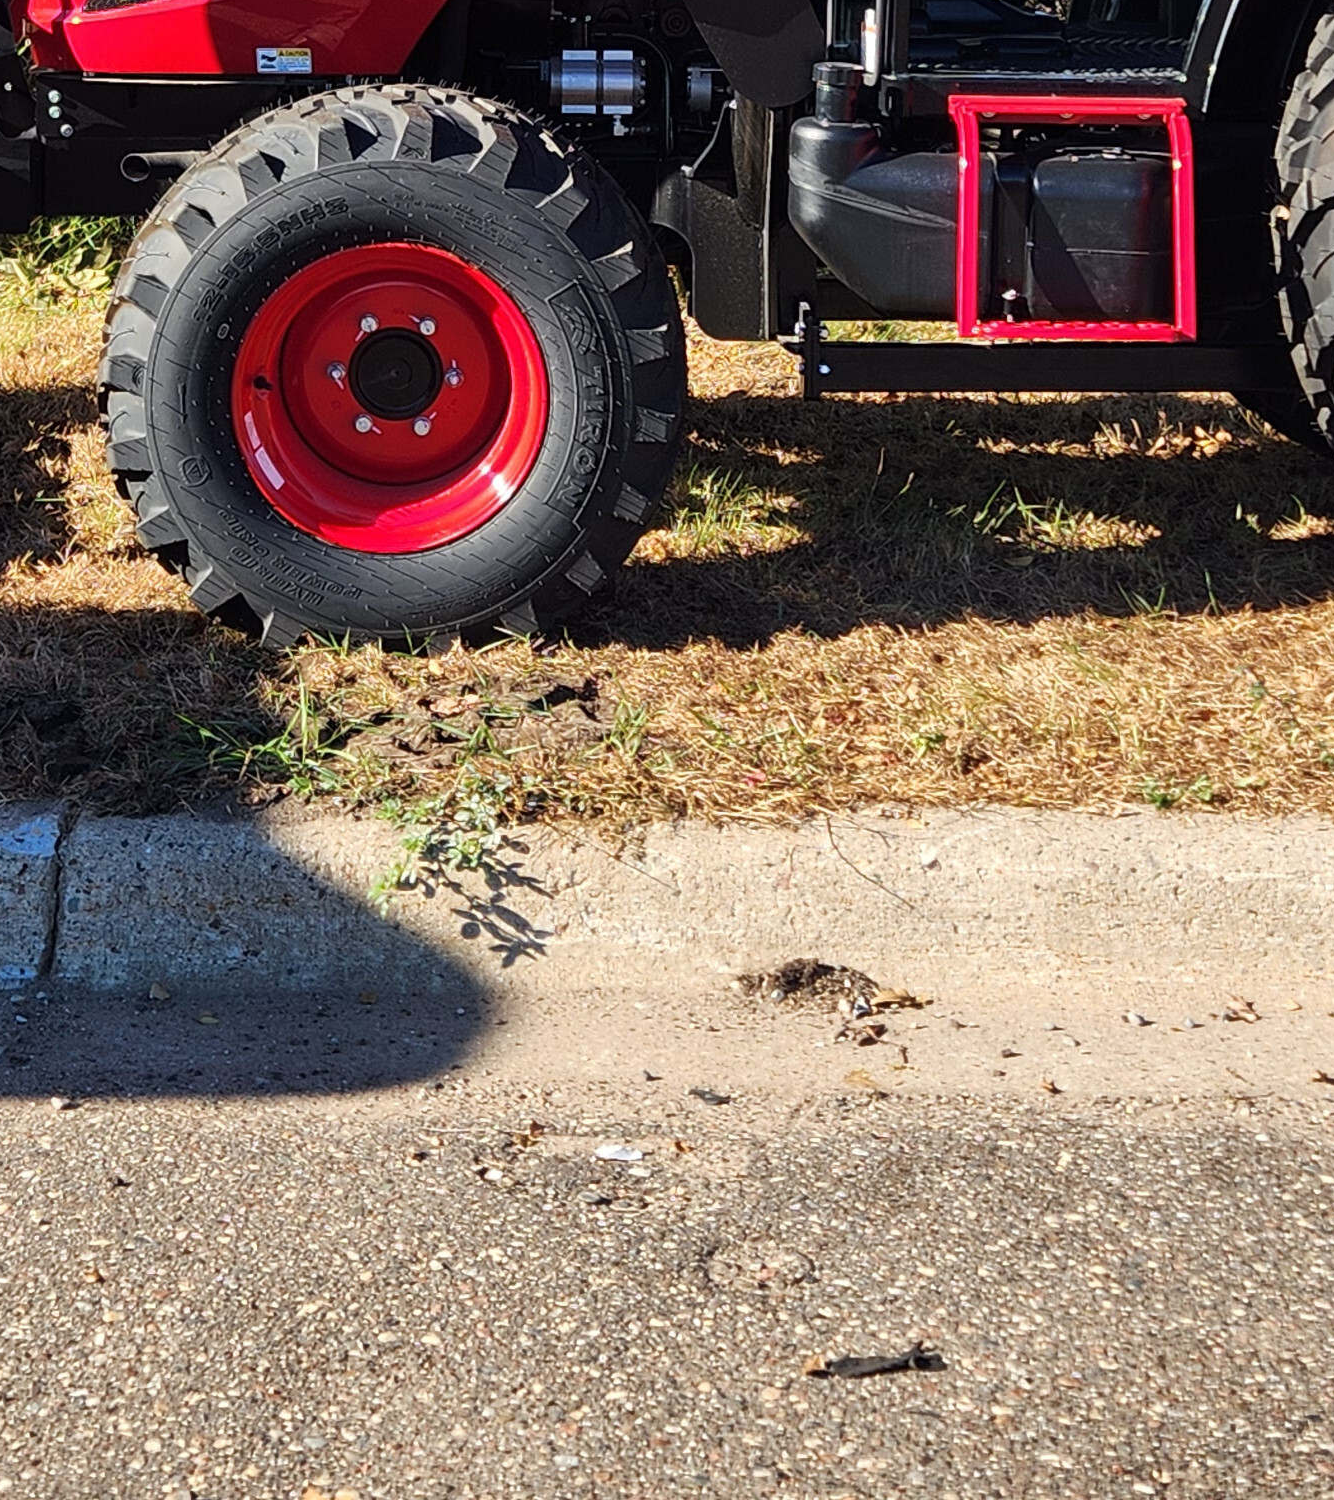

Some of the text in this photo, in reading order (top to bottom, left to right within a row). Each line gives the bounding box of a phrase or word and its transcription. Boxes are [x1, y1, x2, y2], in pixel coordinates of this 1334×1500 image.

[556, 365, 605, 508] TIRON
[217, 509, 270, 560] GRIP
[230, 546, 328, 605] HYBRID
[269, 554, 363, 600] POWER
